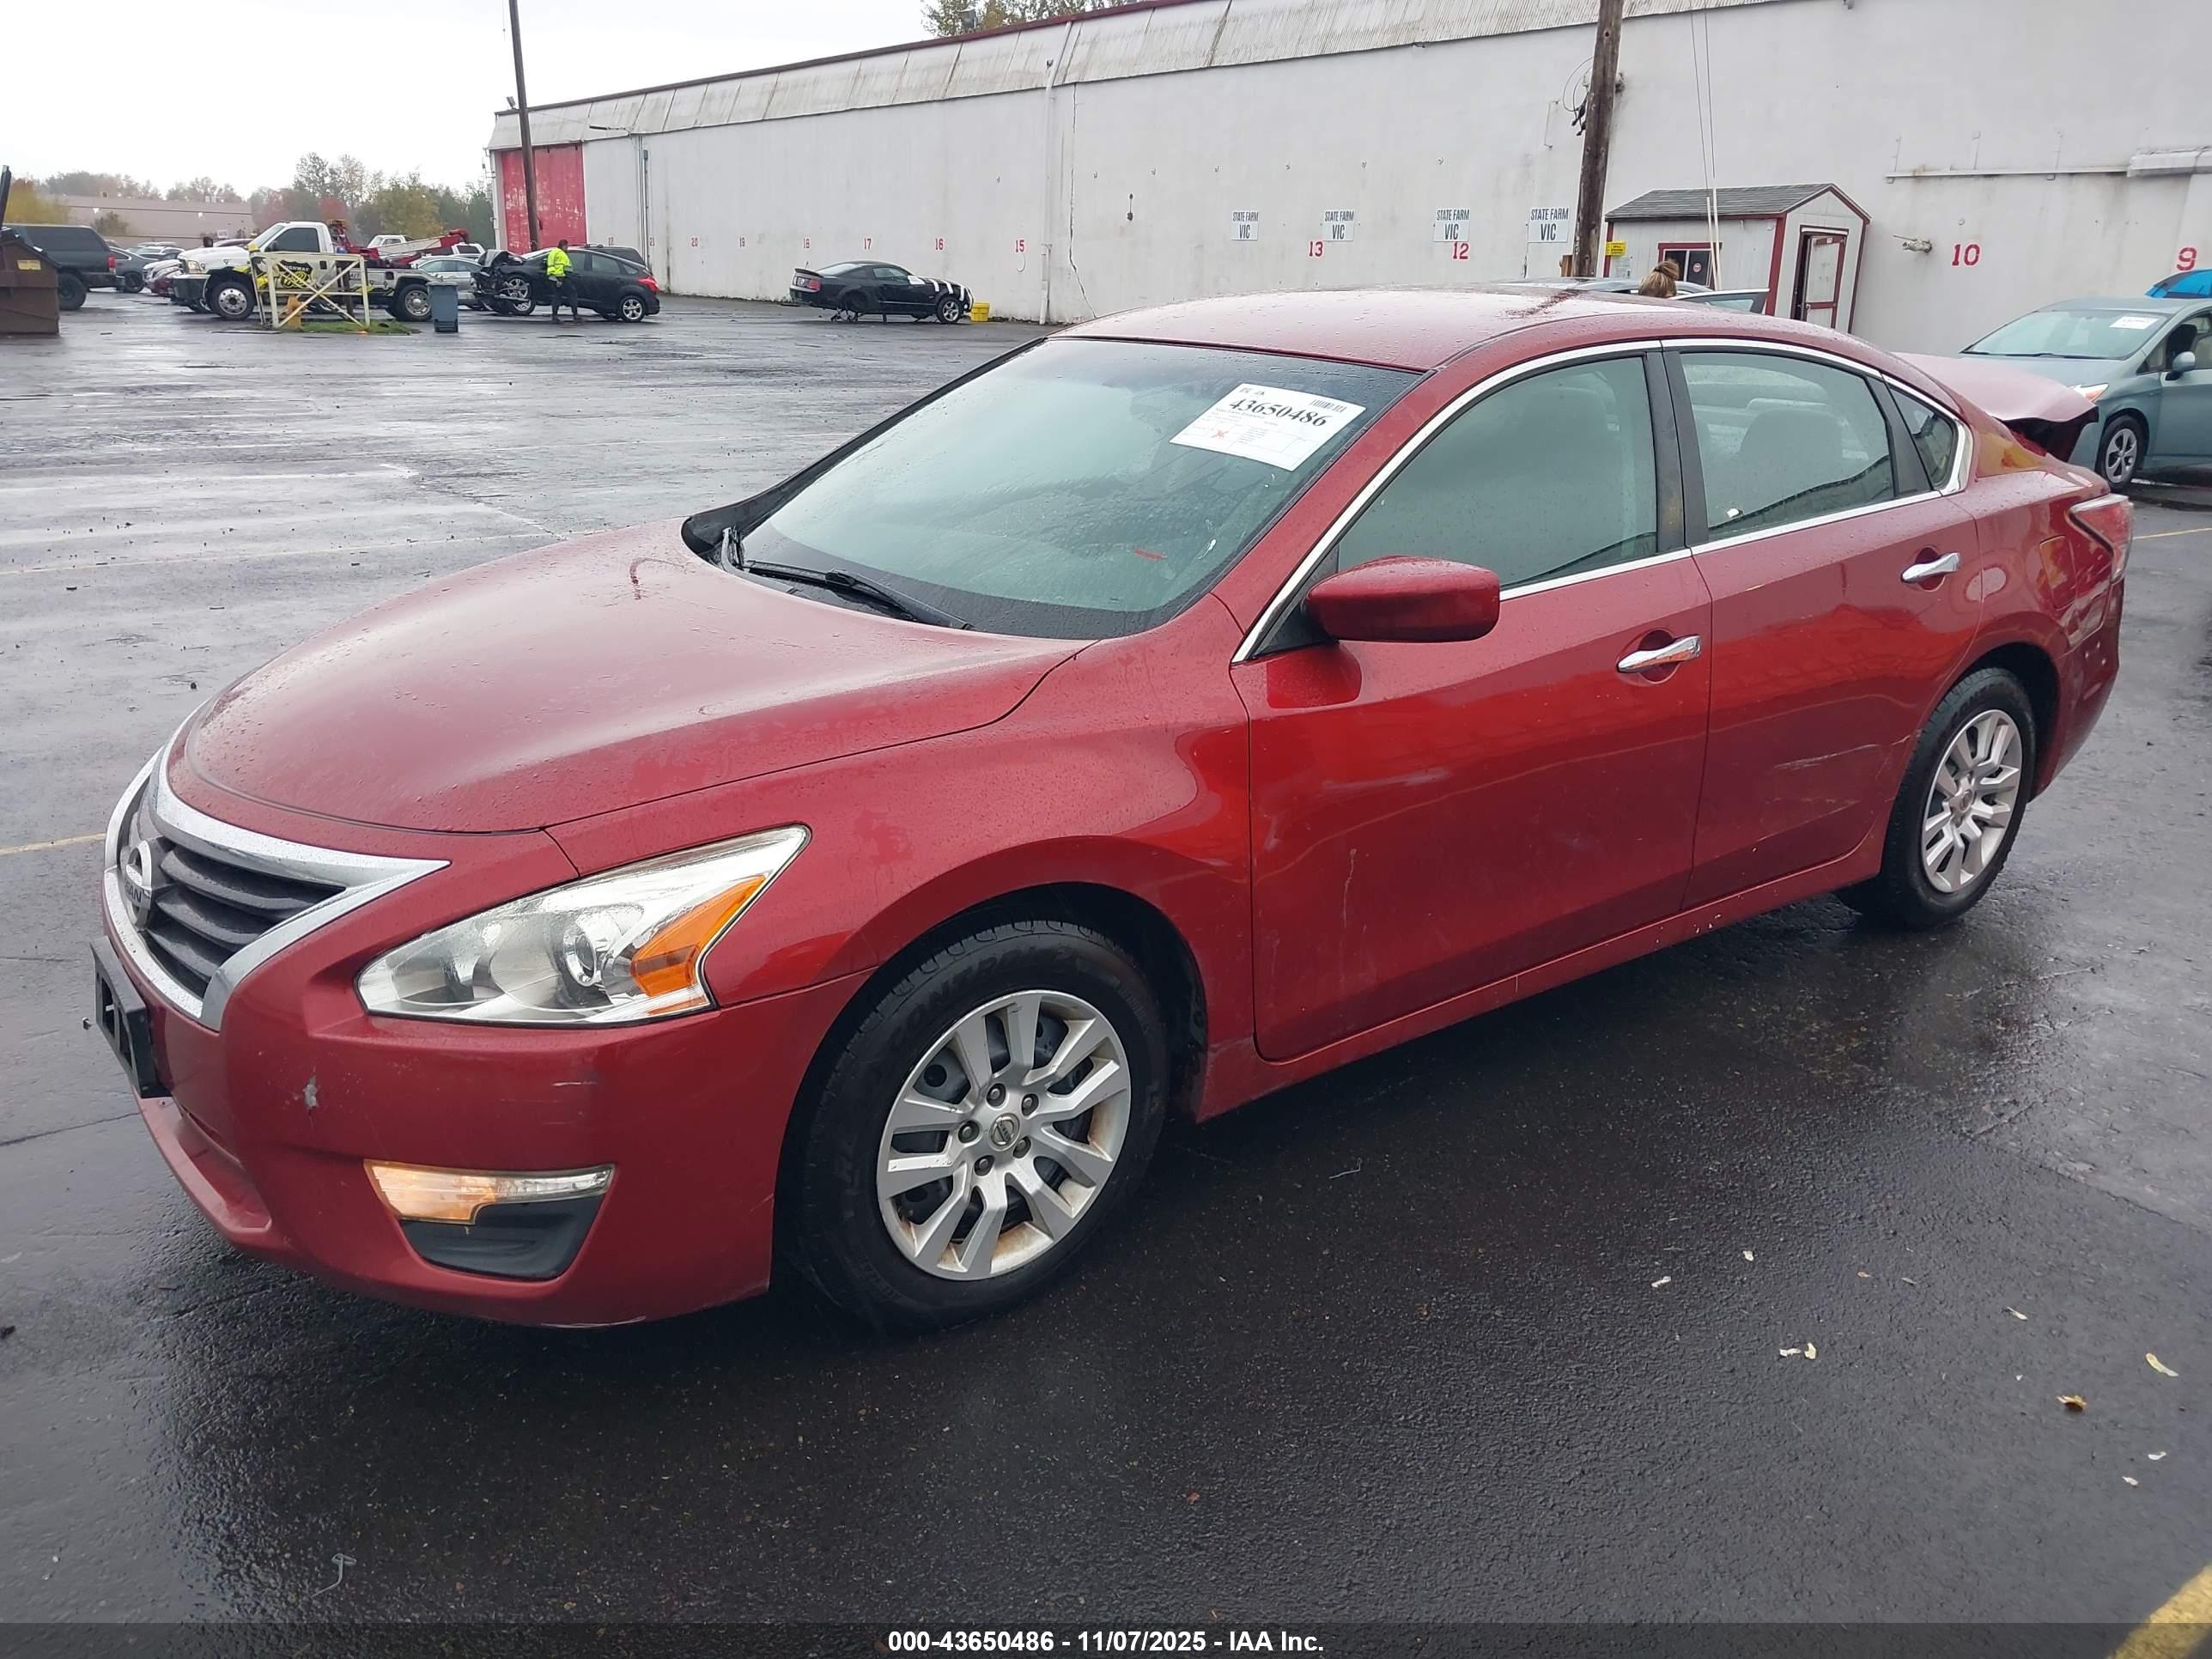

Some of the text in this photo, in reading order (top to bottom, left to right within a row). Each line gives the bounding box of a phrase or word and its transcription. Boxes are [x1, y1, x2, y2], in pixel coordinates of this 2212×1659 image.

[1232, 212, 1259, 222] STATE FARM
[1324, 210, 1354, 222] STATE FARM
[1437, 209, 1469, 221] STATE FARM
[1530, 208, 1569, 221] STATE FARM
[1239, 224, 1250, 239] VIC
[1332, 224, 1345, 240] VIC
[1444, 223, 1459, 240] VIC
[1540, 223, 1556, 241] VIC
[691, 237, 698, 246] 20
[864, 238, 872, 249] 17
[935, 239, 944, 250] 16
[1015, 240, 1025, 252] 15
[1309, 241, 1323, 257] 13
[1453, 242, 1469, 259] 12
[1952, 244, 1980, 266] 10
[2177, 247, 2197, 270] 9
[1230, 399, 1330, 427] 43650486
